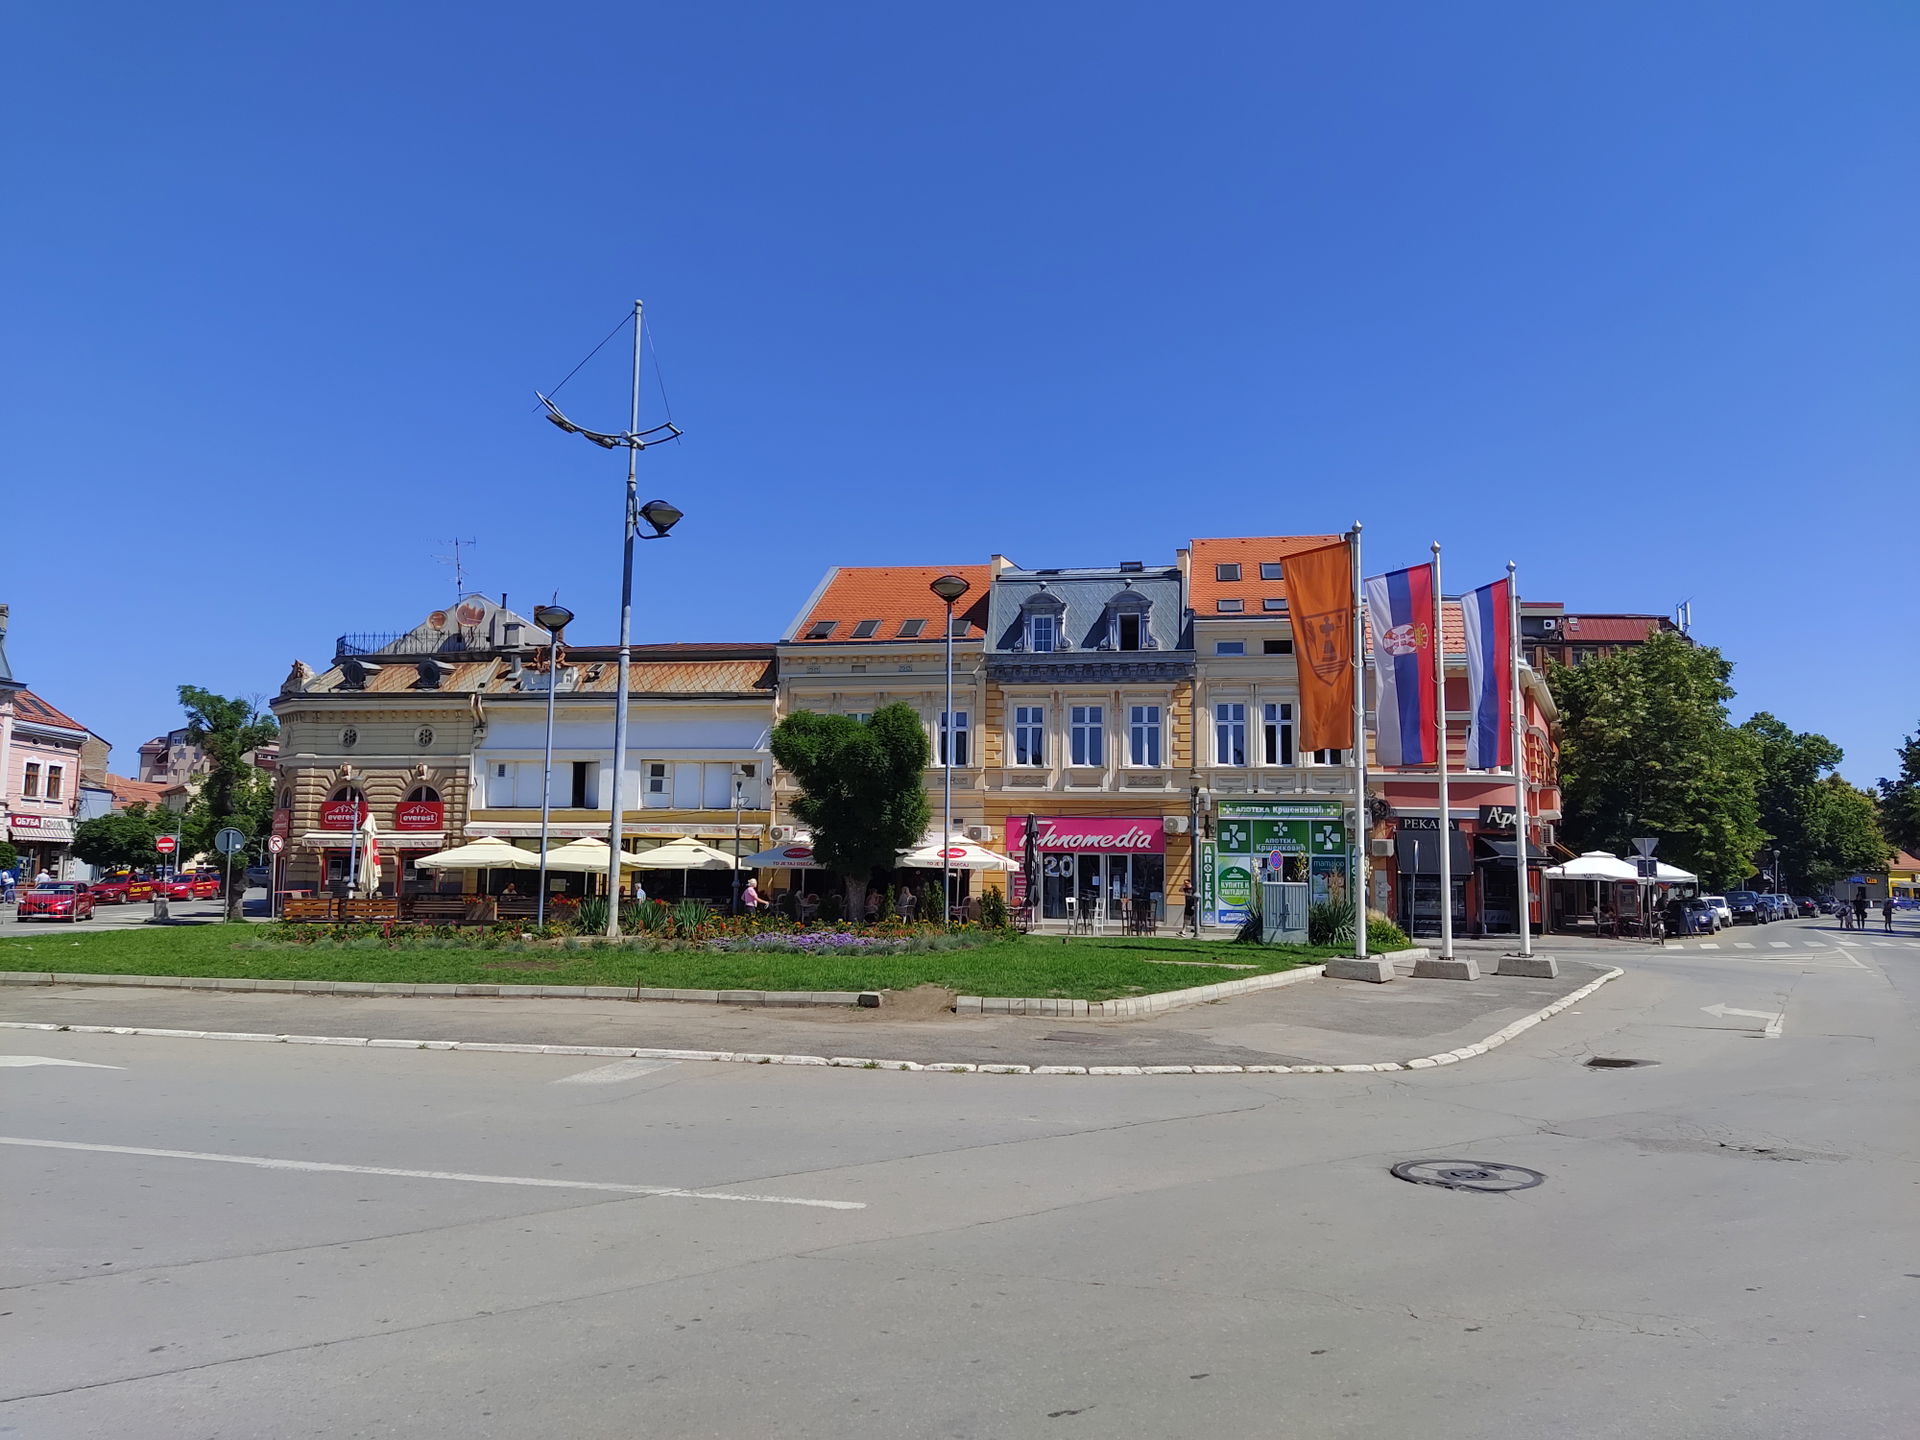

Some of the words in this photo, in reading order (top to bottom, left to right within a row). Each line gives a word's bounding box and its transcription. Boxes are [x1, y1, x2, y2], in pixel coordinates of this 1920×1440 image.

[1018, 820, 1152, 849] Thnomedia
[1403, 818, 1456, 830] PEKAA
[1043, 855, 1074, 878] 20
